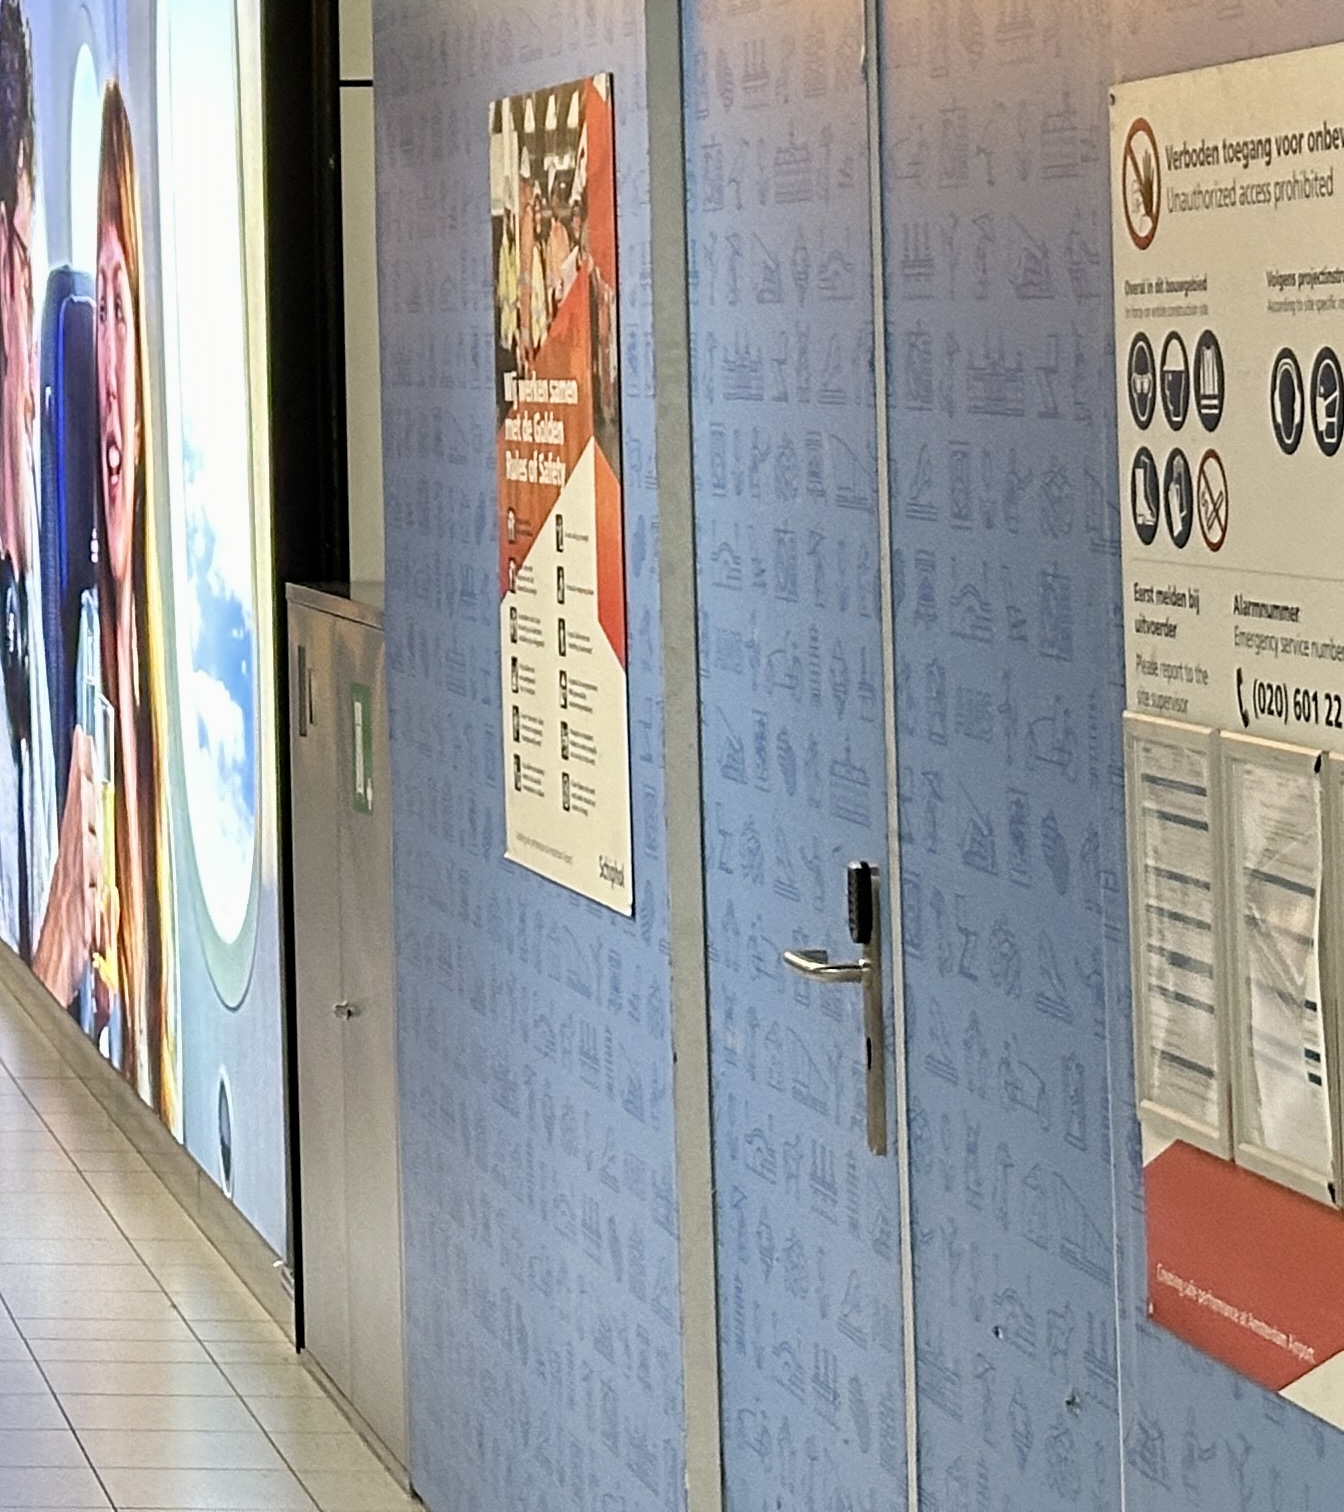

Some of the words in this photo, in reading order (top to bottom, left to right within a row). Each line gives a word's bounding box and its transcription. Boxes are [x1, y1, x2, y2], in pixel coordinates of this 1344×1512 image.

[1165, 139, 1219, 171] Verboden
[1222, 137, 1272, 169] toegang
[1275, 132, 1304, 157] voor
[1166, 178, 1236, 213] Unauthorized
[1239, 181, 1271, 206] access
[1274, 166, 1334, 210] prohibited
[1188, 586, 1200, 616] bij
[1233, 593, 1300, 623] Alarmnummer
[1234, 625, 1278, 658] Emergency
[1280, 633, 1310, 657] service
[1253, 678, 1289, 725] (020)
[1293, 687, 1319, 725] 601
[1324, 692, 1343, 729] 22
